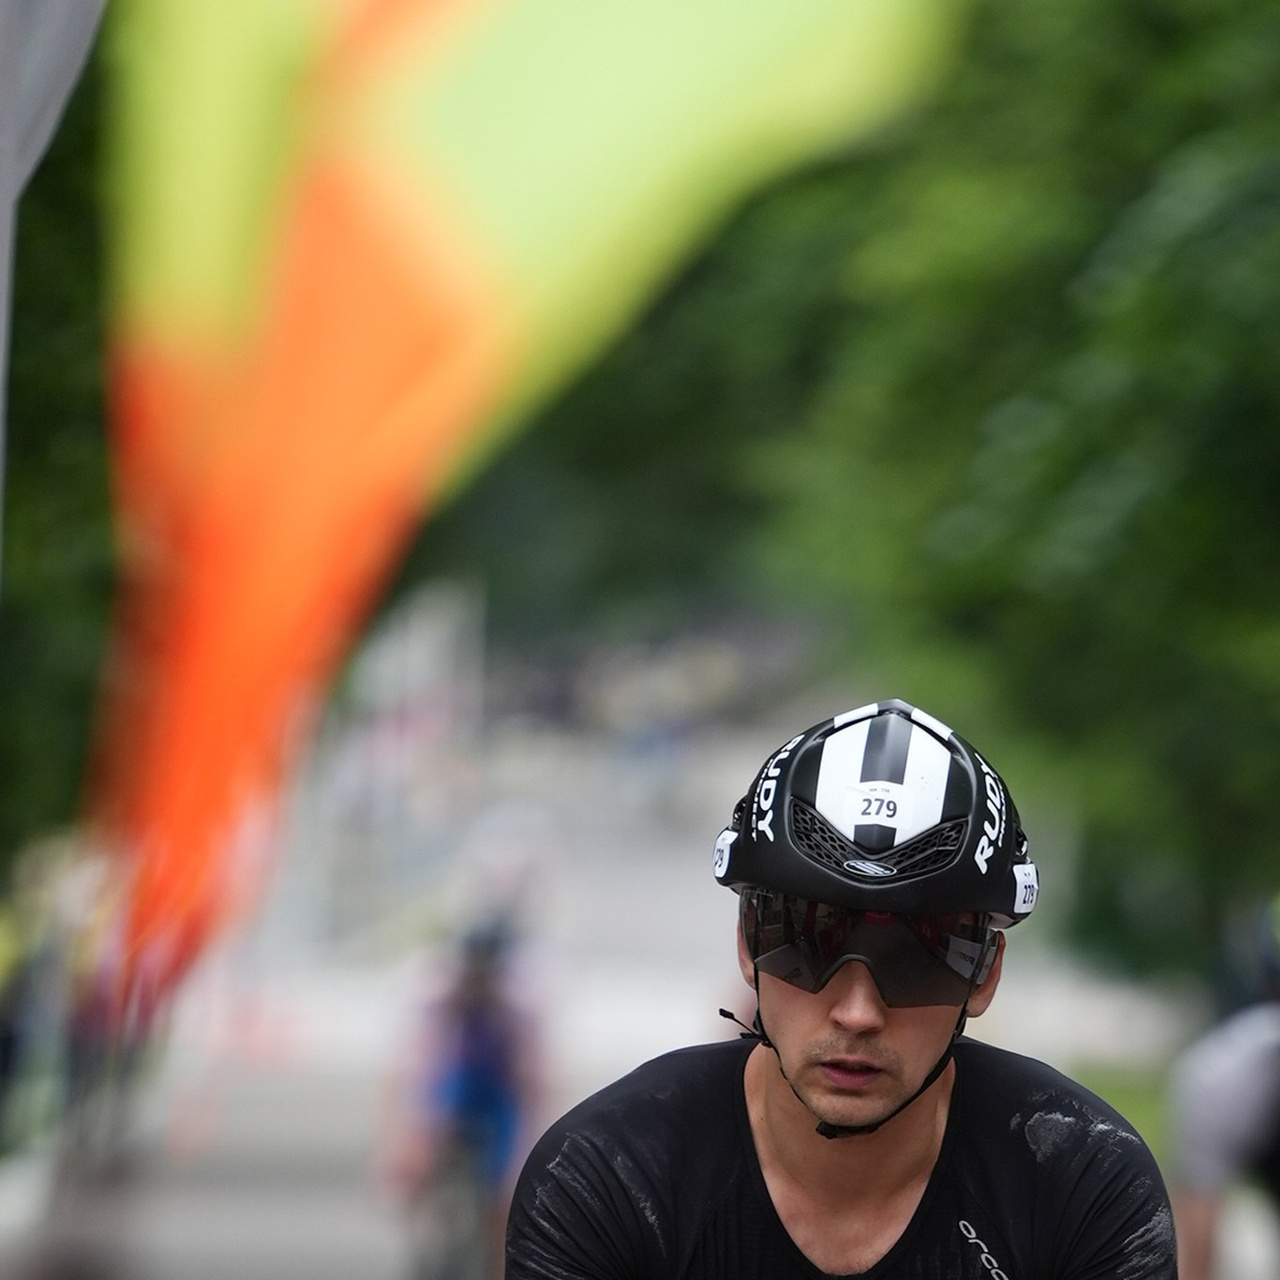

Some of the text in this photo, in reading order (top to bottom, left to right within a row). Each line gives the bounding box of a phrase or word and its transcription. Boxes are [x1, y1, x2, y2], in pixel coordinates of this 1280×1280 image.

[757, 734, 806, 843] RUDY
[860, 797, 898, 819] 279
[974, 752, 1001, 875] RUDY
